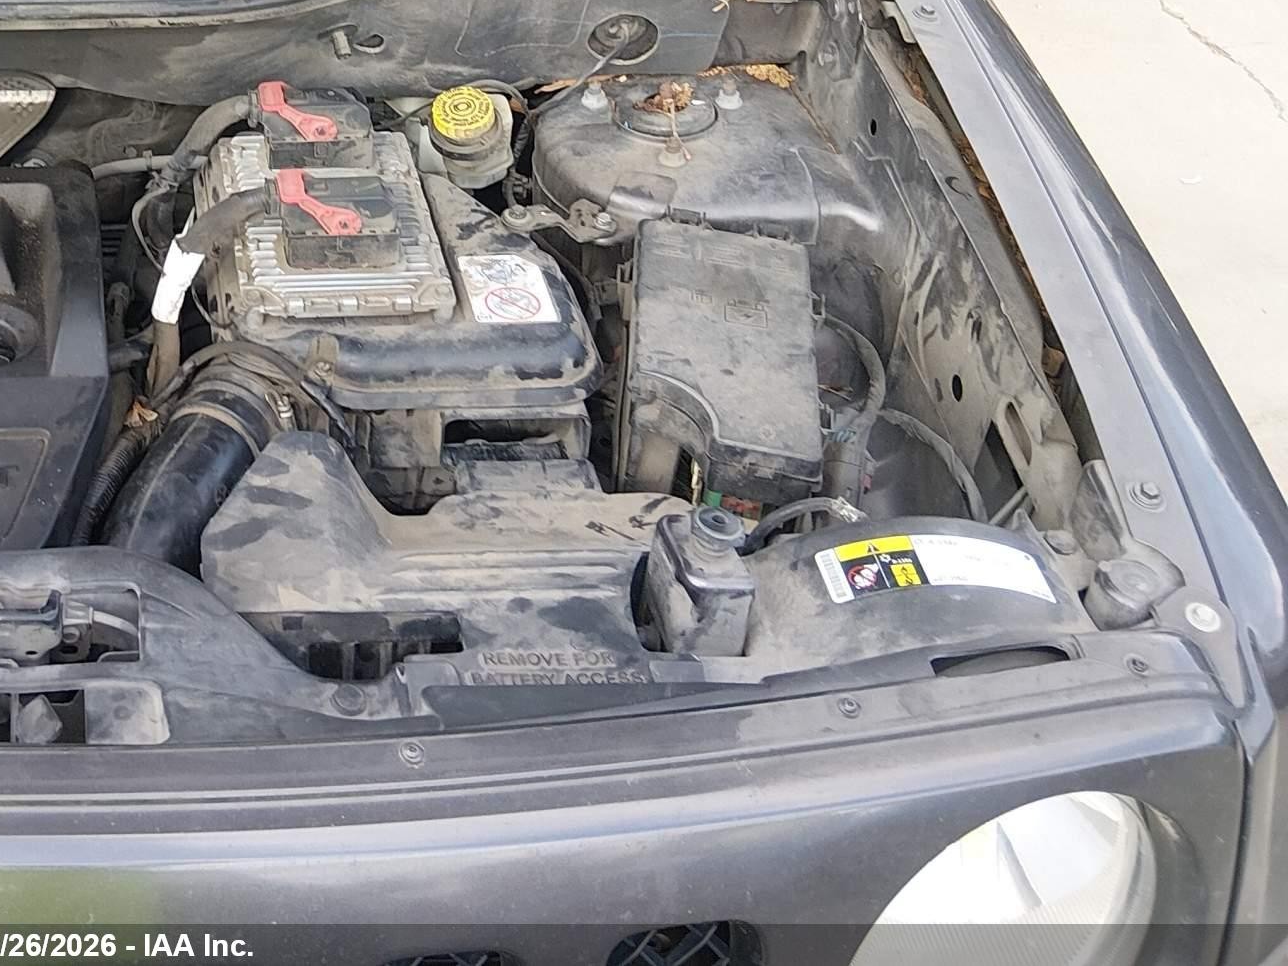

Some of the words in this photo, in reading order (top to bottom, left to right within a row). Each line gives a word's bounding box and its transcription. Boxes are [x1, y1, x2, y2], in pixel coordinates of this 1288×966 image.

[482, 650, 568, 667] REMOVE
[574, 651, 614, 667] FOR
[471, 671, 555, 685] BATTERY
[563, 671, 646, 684] ACCESS
